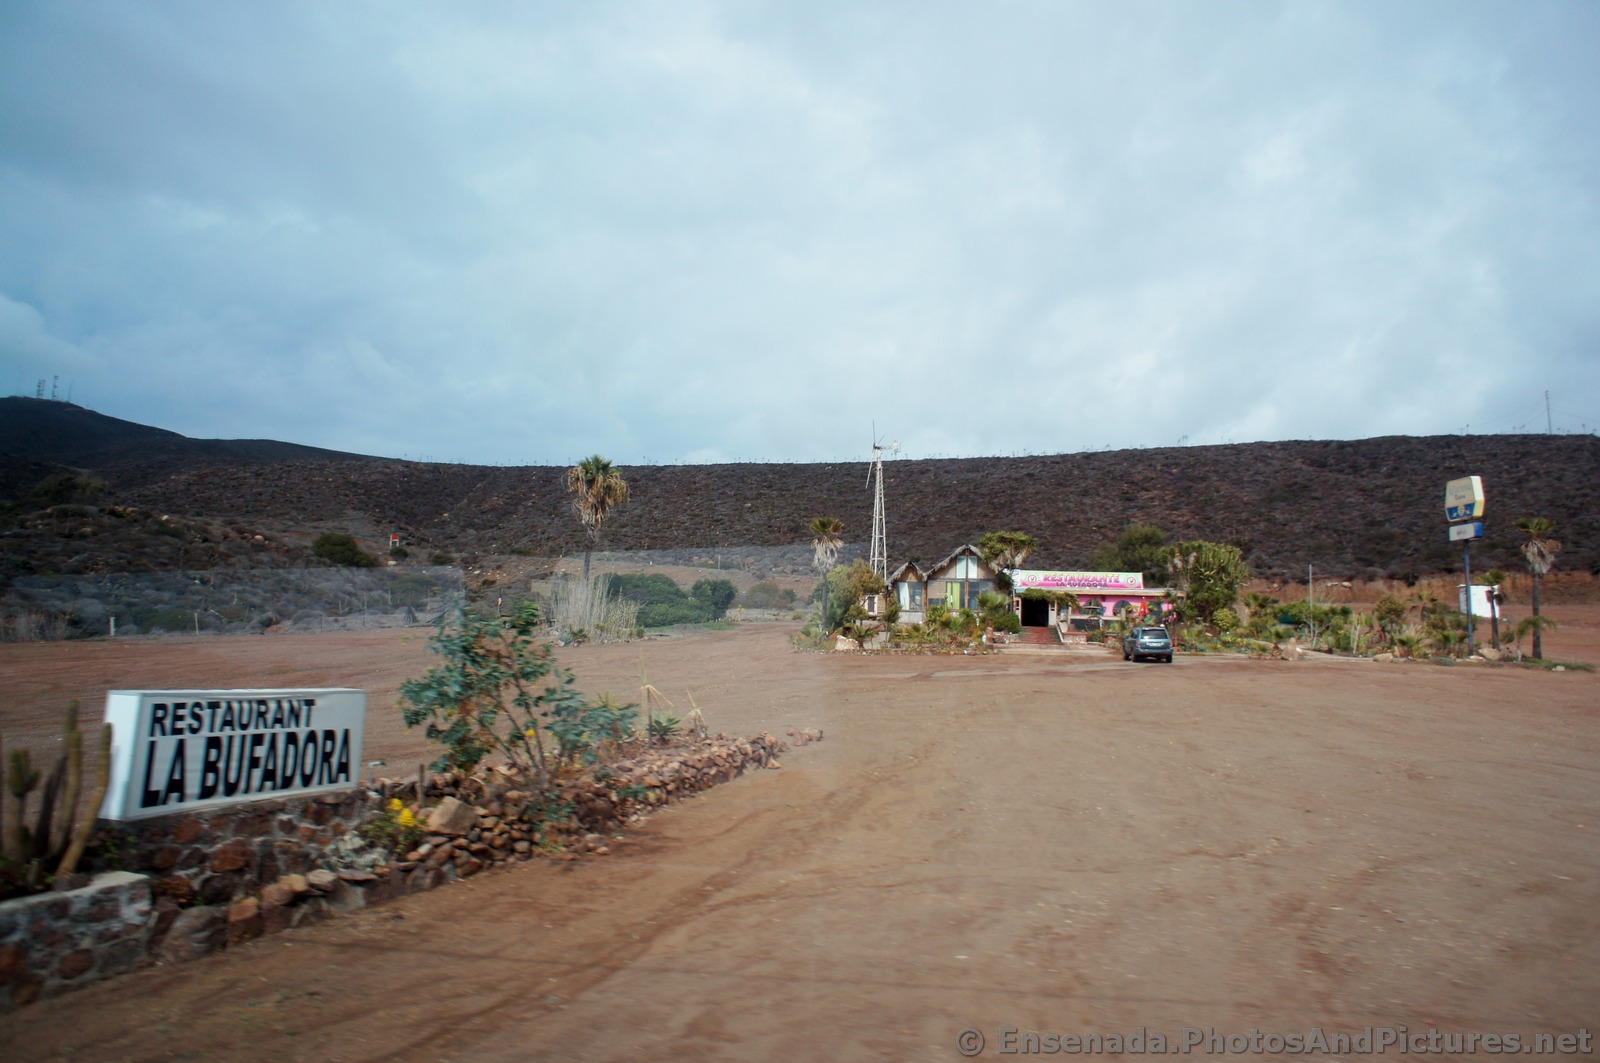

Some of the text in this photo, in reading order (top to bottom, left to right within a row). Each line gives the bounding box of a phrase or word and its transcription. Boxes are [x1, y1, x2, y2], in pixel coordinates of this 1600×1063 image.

[1043, 573, 1120, 583] RESTAURANTE
[149, 698, 317, 738] RESTAURANT
[141, 728, 351, 808] LA BUFADORA
